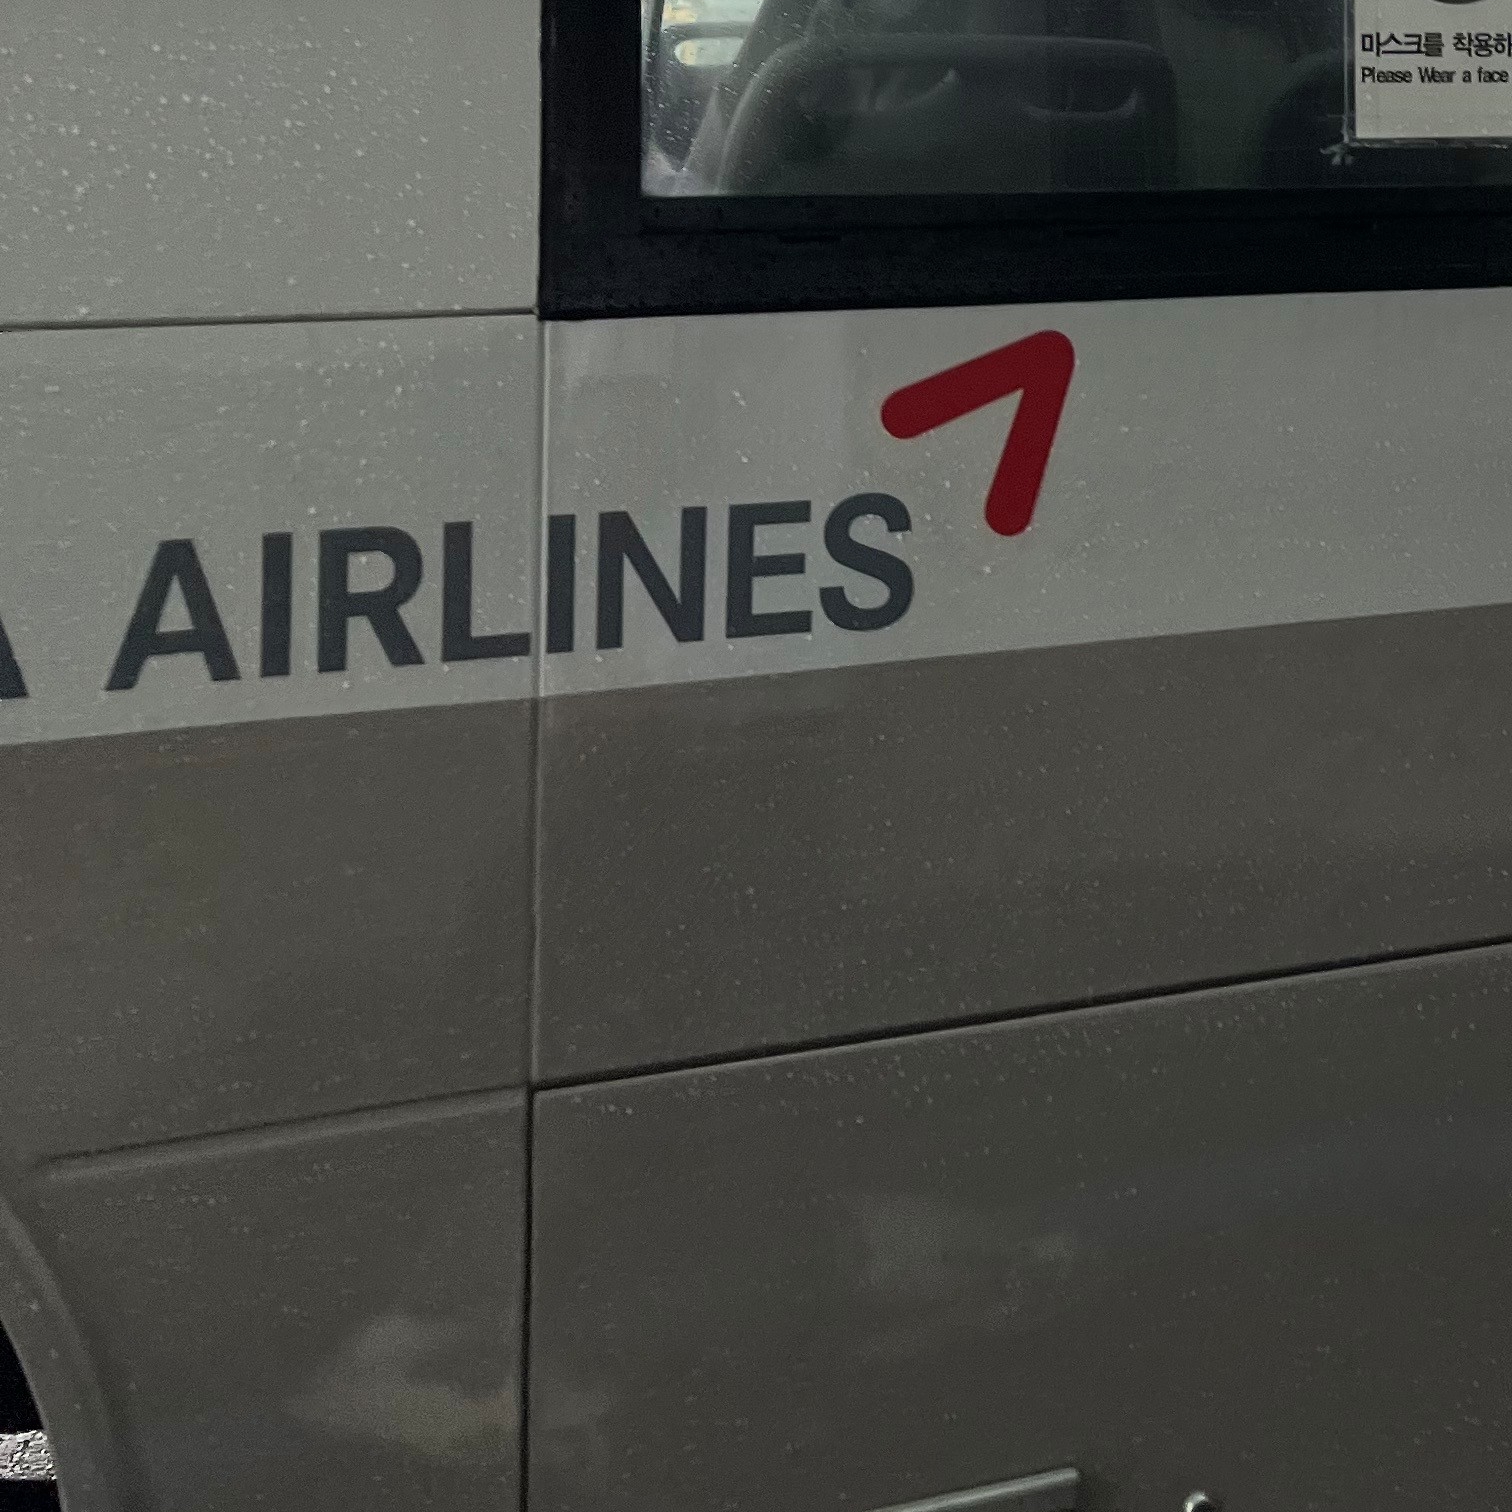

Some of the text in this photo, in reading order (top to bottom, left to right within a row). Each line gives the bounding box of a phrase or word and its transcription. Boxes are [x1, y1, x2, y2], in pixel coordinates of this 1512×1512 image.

[1361, 32, 1444, 57] 마스크를
[1361, 66, 1412, 83] Please
[1418, 66, 1456, 83] Wear
[1462, 71, 1472, 83] a
[1478, 66, 1509, 83] face
[104, 492, 915, 691] AIRLINES
